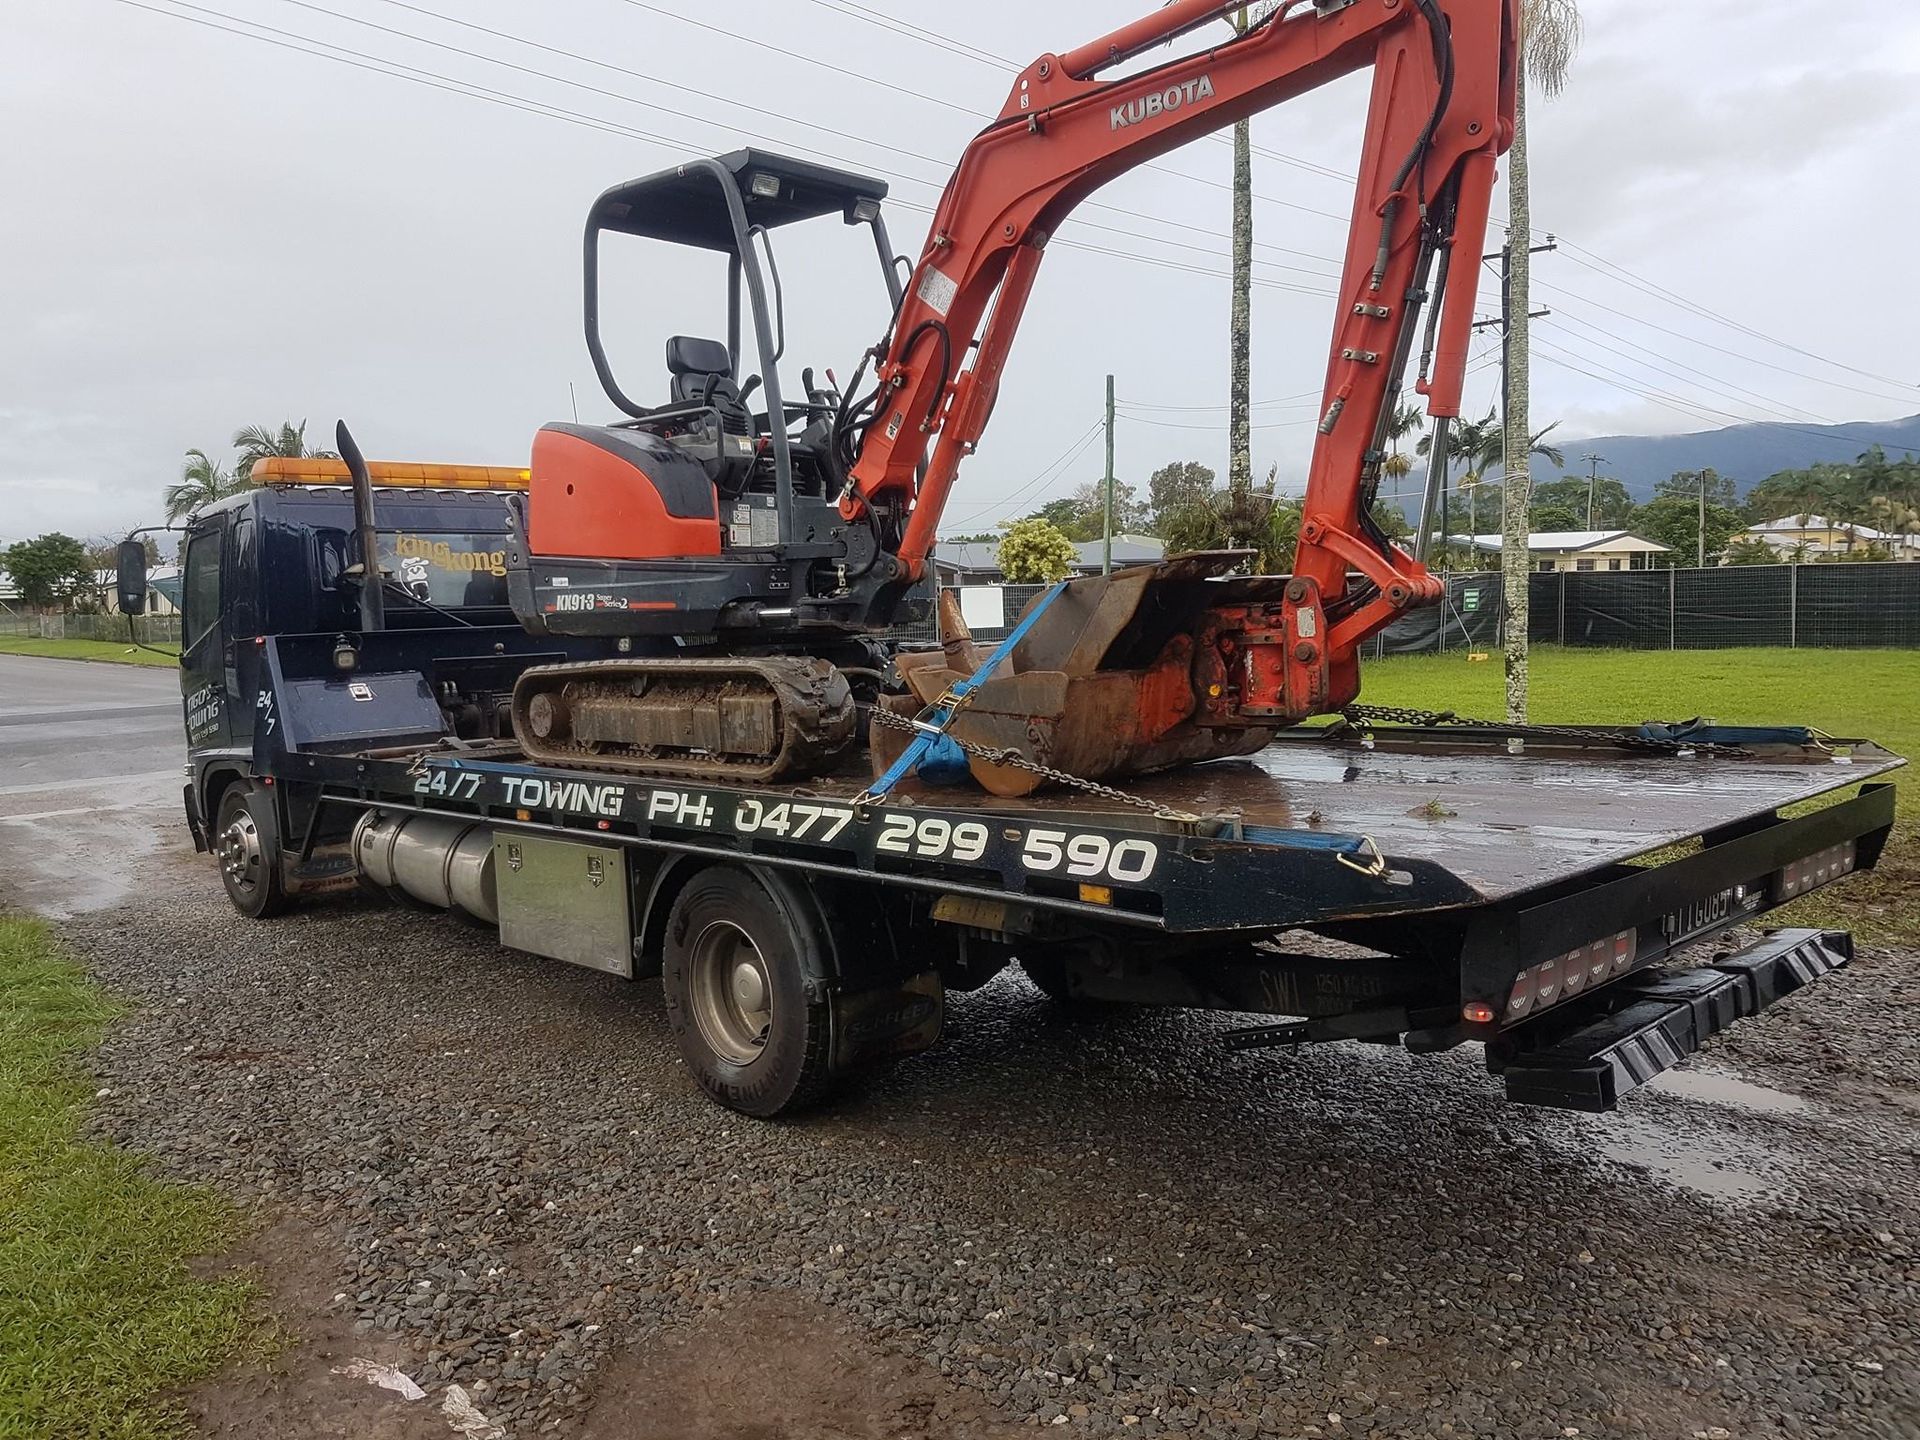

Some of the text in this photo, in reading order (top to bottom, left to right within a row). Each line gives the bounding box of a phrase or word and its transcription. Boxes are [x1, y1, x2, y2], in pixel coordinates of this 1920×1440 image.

[1110, 74, 1216, 131] KUBOTA
[447, 549, 508, 577] kong
[596, 593, 613, 602] Super
[414, 772, 1158, 883] 24/7 TOWING PH: 0477 299 590
